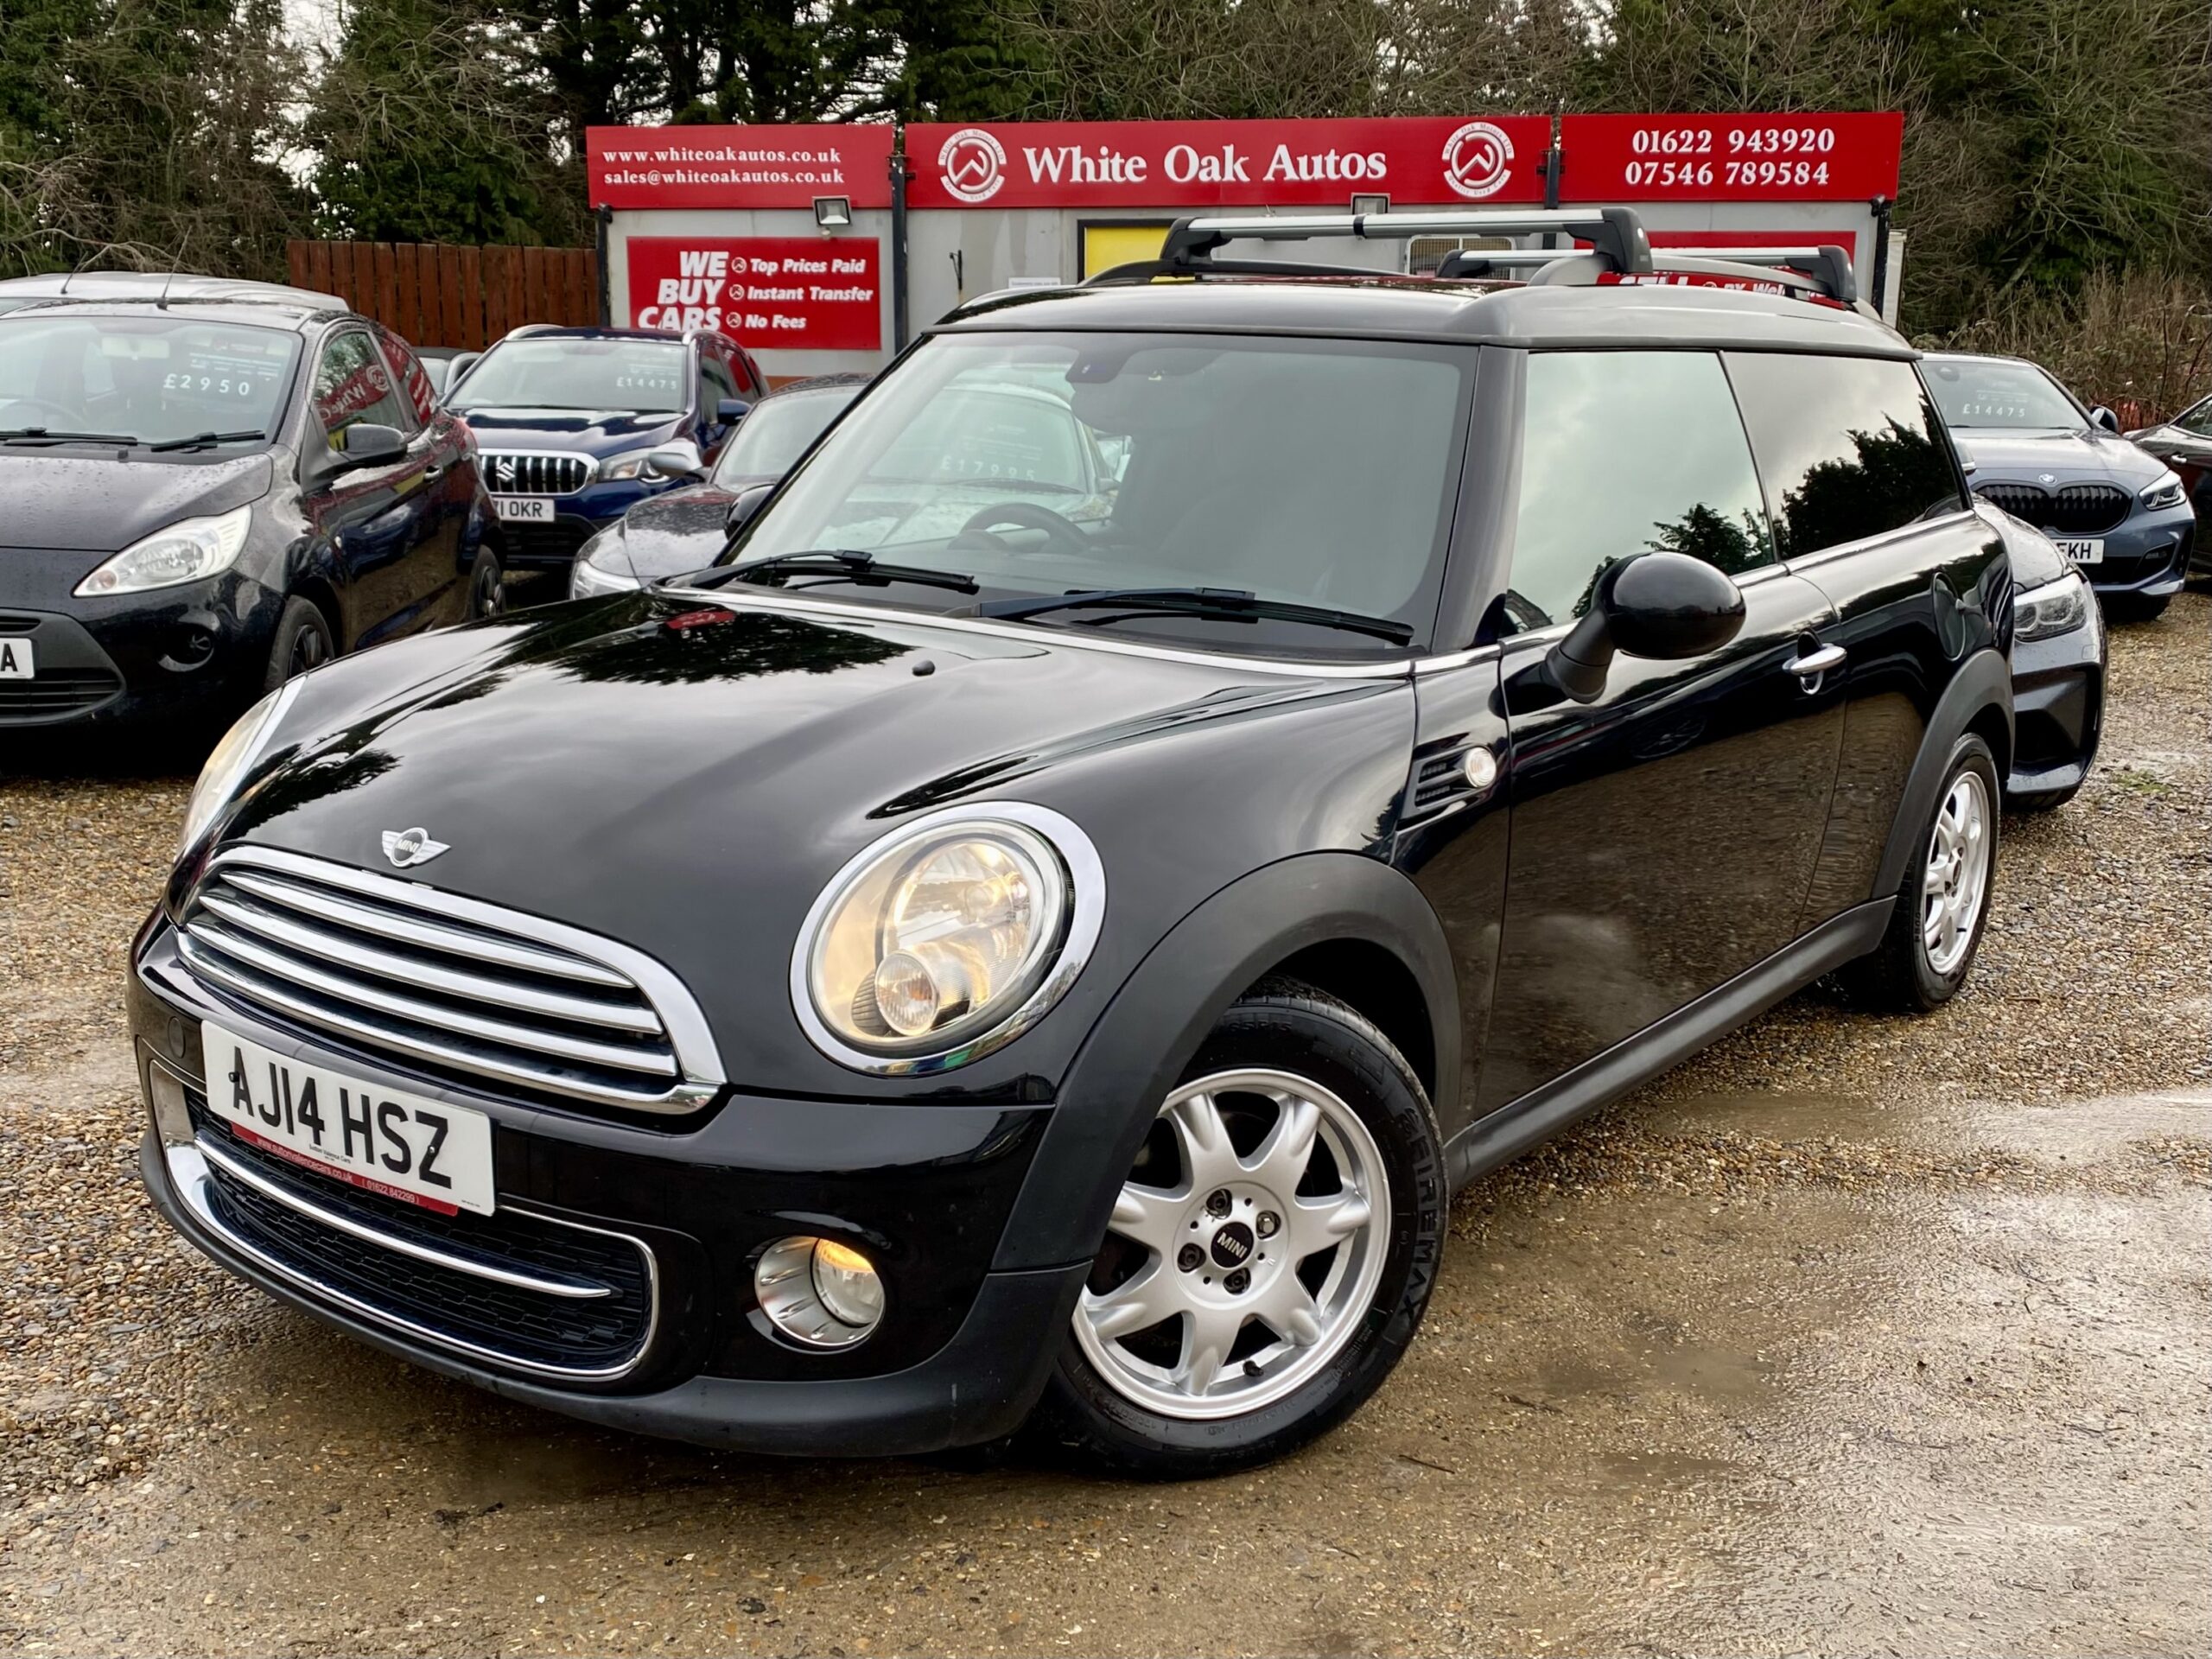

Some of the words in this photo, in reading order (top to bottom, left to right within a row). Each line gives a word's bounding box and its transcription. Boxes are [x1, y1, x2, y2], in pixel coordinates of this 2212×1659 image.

[1632, 129, 1712, 153] 01622
[1728, 128, 1835, 153] 943920
[603, 146, 841, 162] www.whiteoakautos.co.uk
[1022, 145, 1147, 182] White
[1164, 144, 1250, 182] Oak
[1262, 143, 1387, 181] Autos
[604, 168, 845, 186] sales@whiteoakautos.co.uk
[1625, 162, 1713, 186] 07546
[1726, 161, 1829, 186] 789584
[680, 251, 729, 277] WE
[750, 257, 779, 276] Top
[782, 257, 827, 274] Prices
[831, 258, 866, 274] Paid
[658, 278, 726, 305] BUY
[747, 285, 804, 301] Instant
[810, 285, 874, 301] Transfer
[638, 306, 721, 333] CARS
[745, 314, 768, 328] No
[772, 314, 807, 328] Fees
[162, 372, 250, 396] £2950
[509, 501, 543, 518] OKR
[396, 838, 421, 854] MINI
[229, 1046, 326, 1147] AJ14
[340, 1087, 453, 1190] HSZ
[1217, 1231, 1248, 1259] MINI
